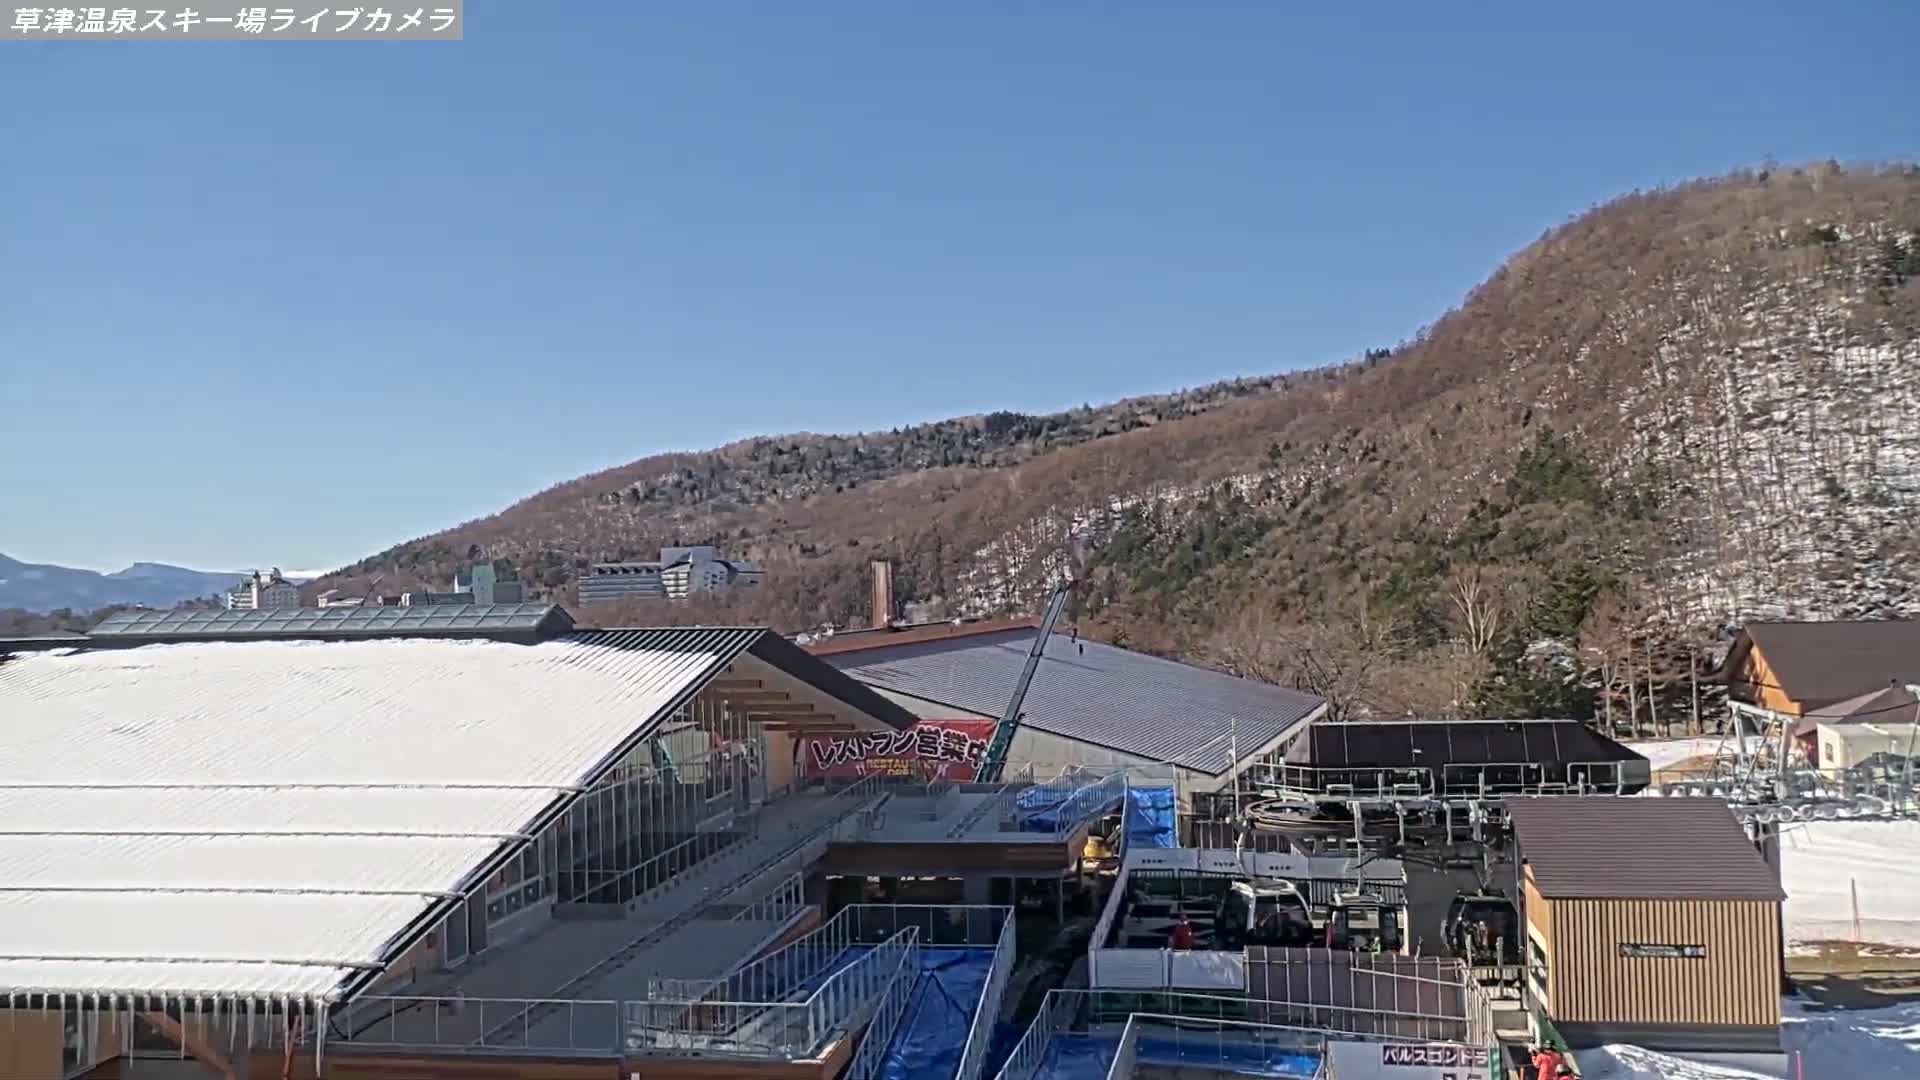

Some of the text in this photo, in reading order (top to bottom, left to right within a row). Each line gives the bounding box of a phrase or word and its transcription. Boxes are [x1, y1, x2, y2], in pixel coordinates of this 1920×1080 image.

[811, 726, 988, 769] レストラン営業中
